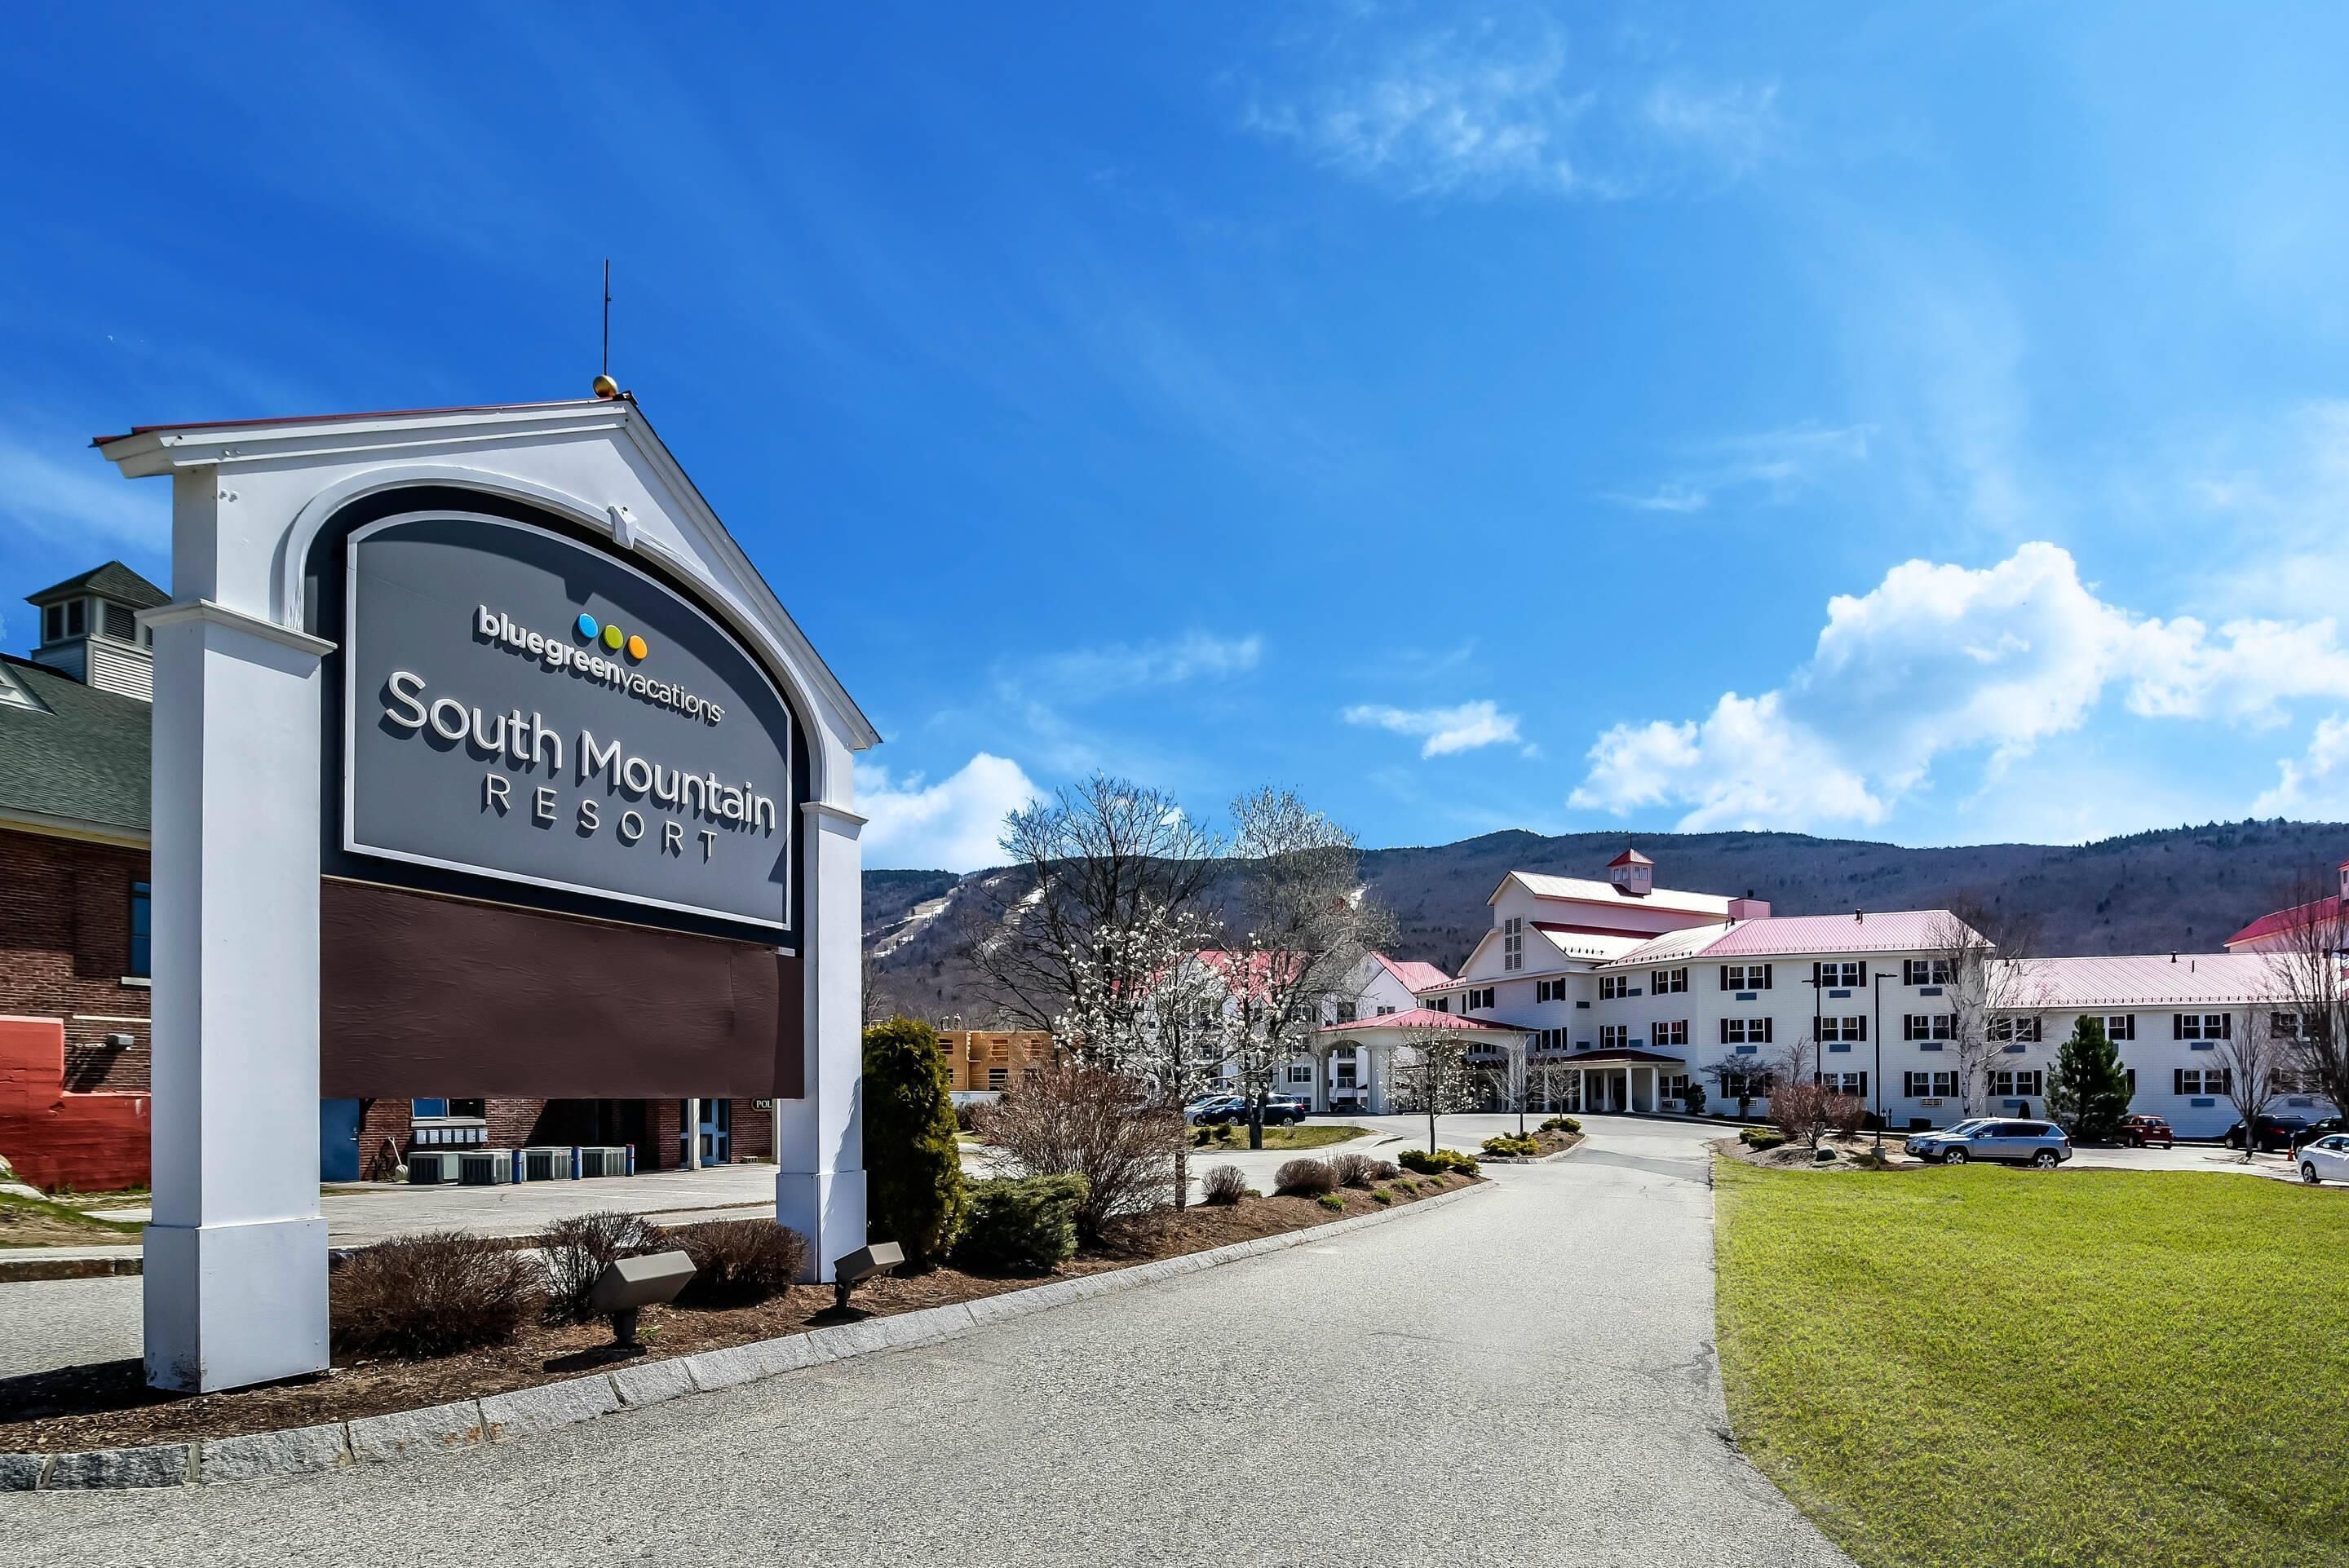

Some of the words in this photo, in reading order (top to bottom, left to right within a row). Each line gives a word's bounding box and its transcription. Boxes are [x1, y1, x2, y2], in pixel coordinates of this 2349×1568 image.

[386, 671, 562, 769] South
[582, 731, 775, 828] Mountain
[487, 773, 718, 857] RESORT
